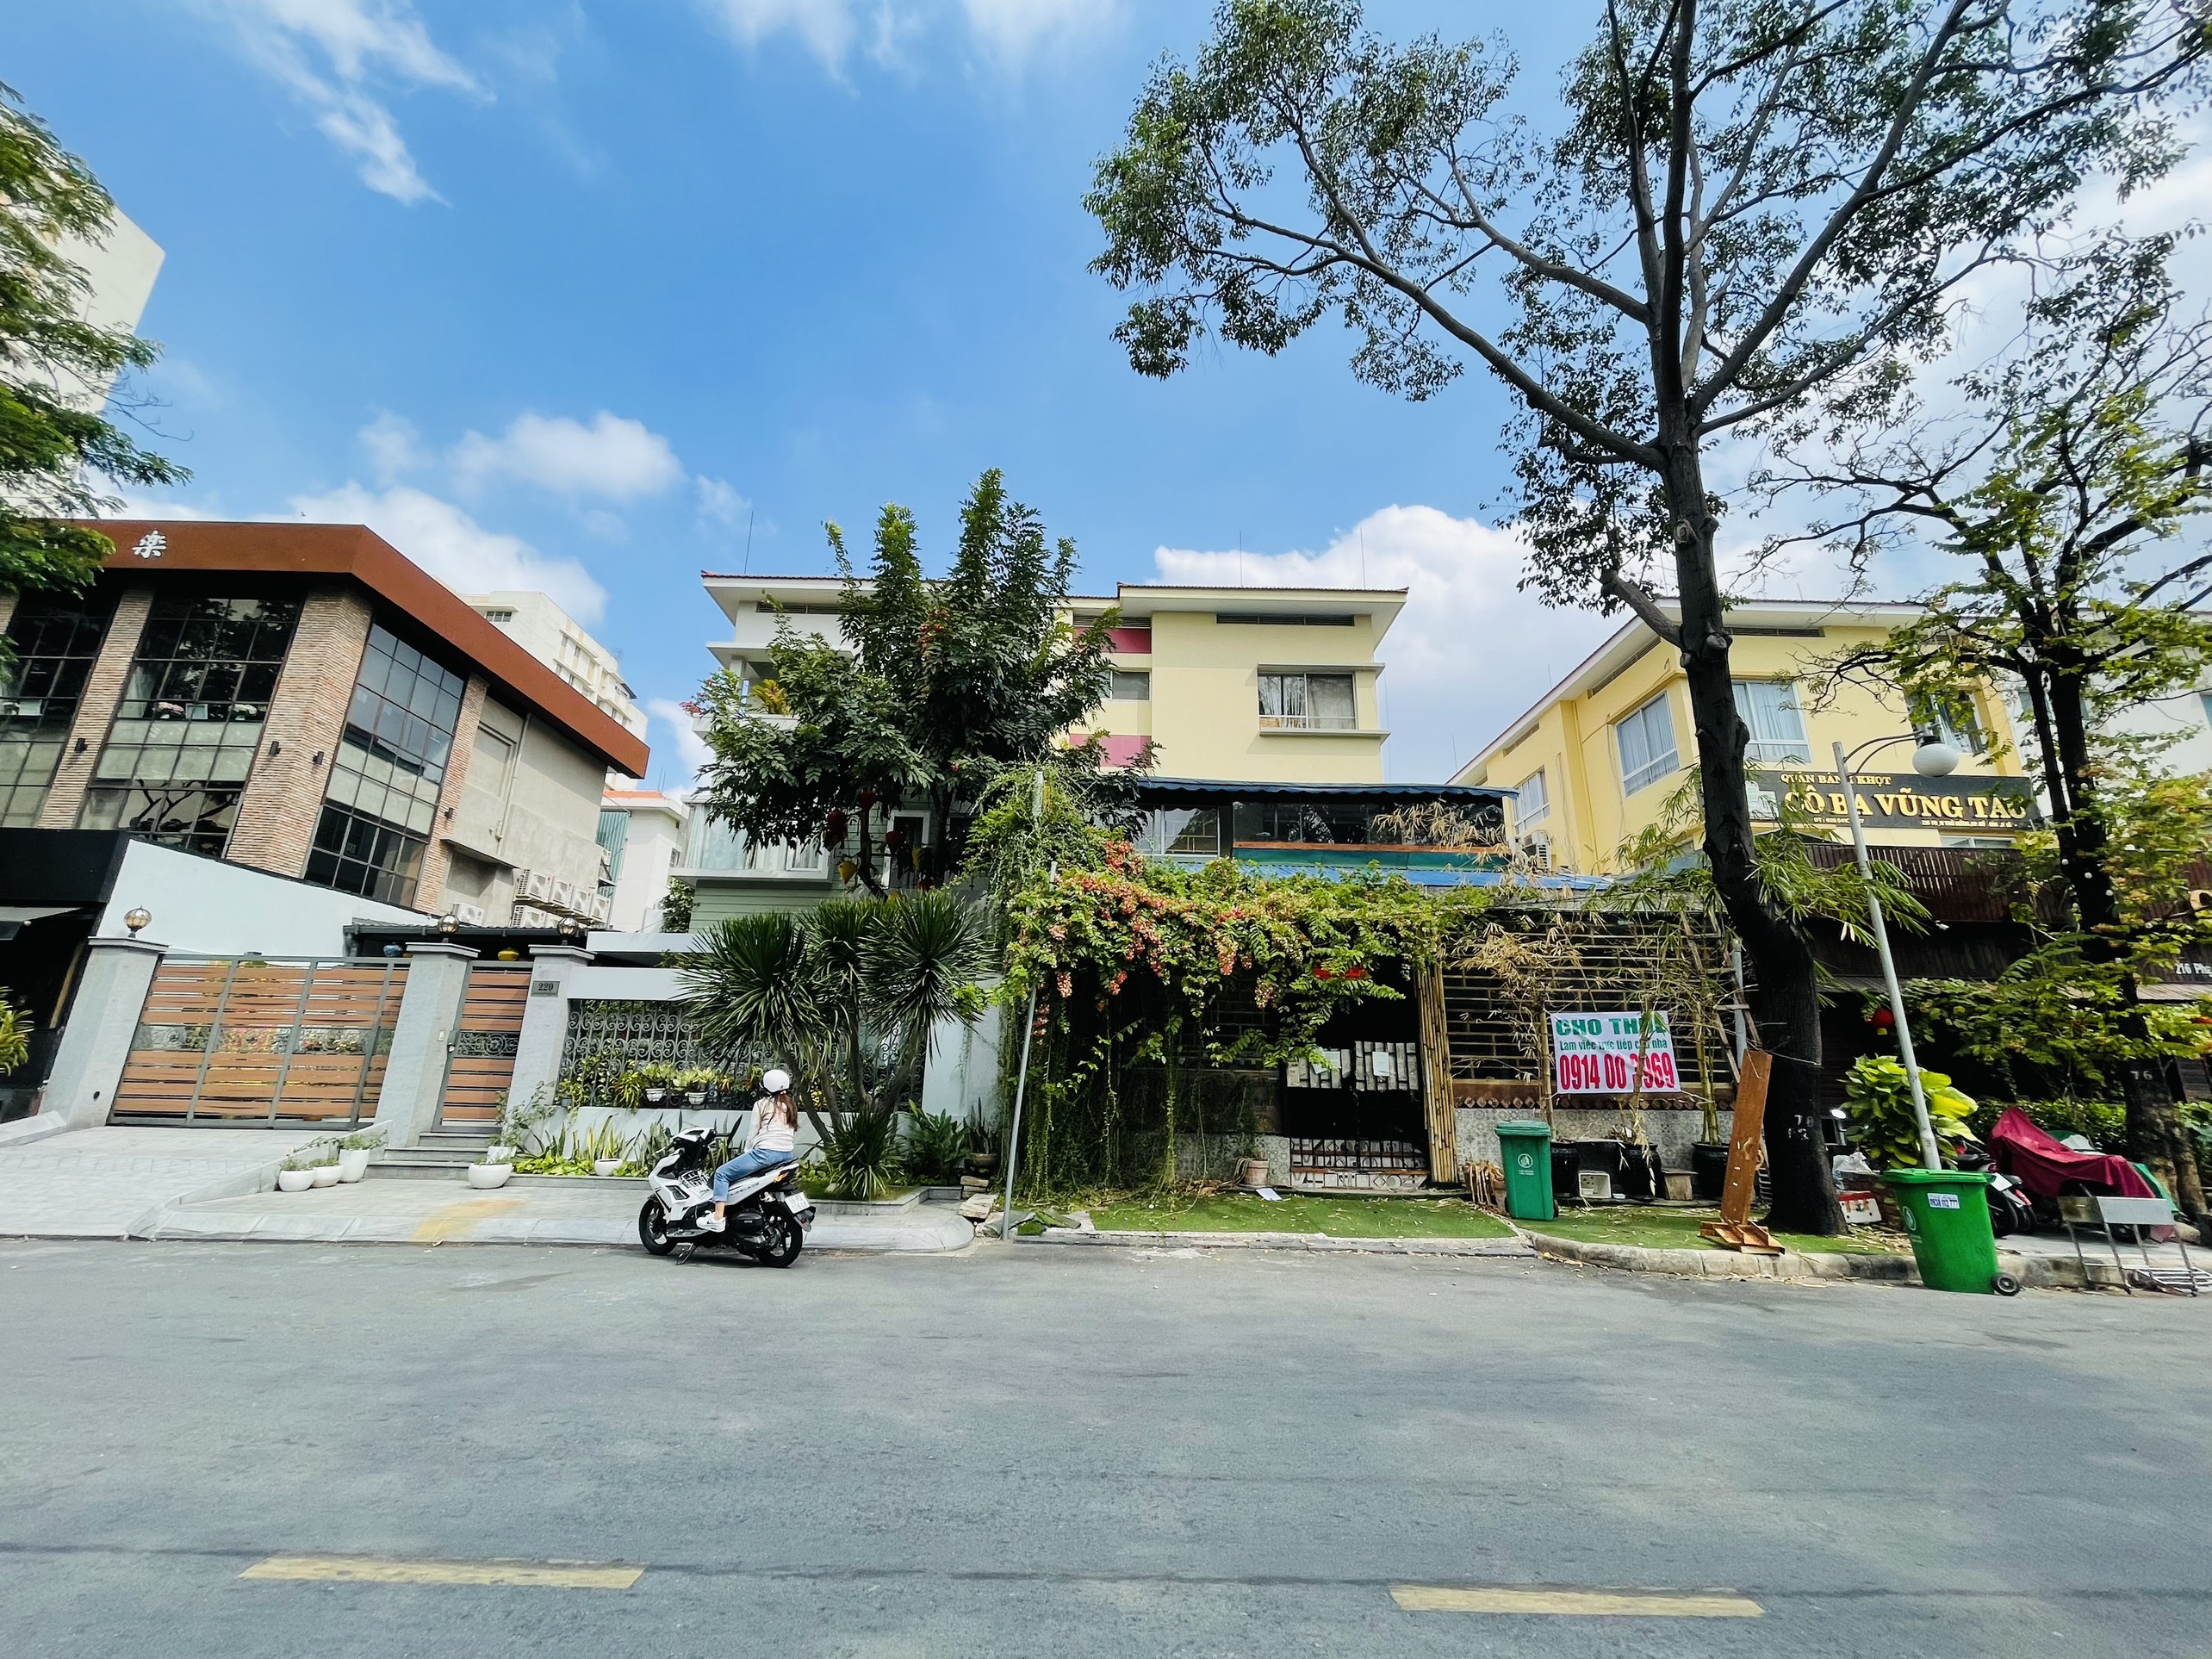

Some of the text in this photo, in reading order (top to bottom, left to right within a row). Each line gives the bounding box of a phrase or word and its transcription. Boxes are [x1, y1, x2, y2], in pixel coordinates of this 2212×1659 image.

[1856, 775, 1892, 786] KHỌT
[1828, 792, 1873, 816] BA
[1873, 787, 1964, 818] VŨNG
[538, 982, 554, 991] 220
[1556, 1018, 1603, 1036] CHO
[1559, 1053, 1600, 1090] 0914
[1604, 1053, 1627, 1090] 00
